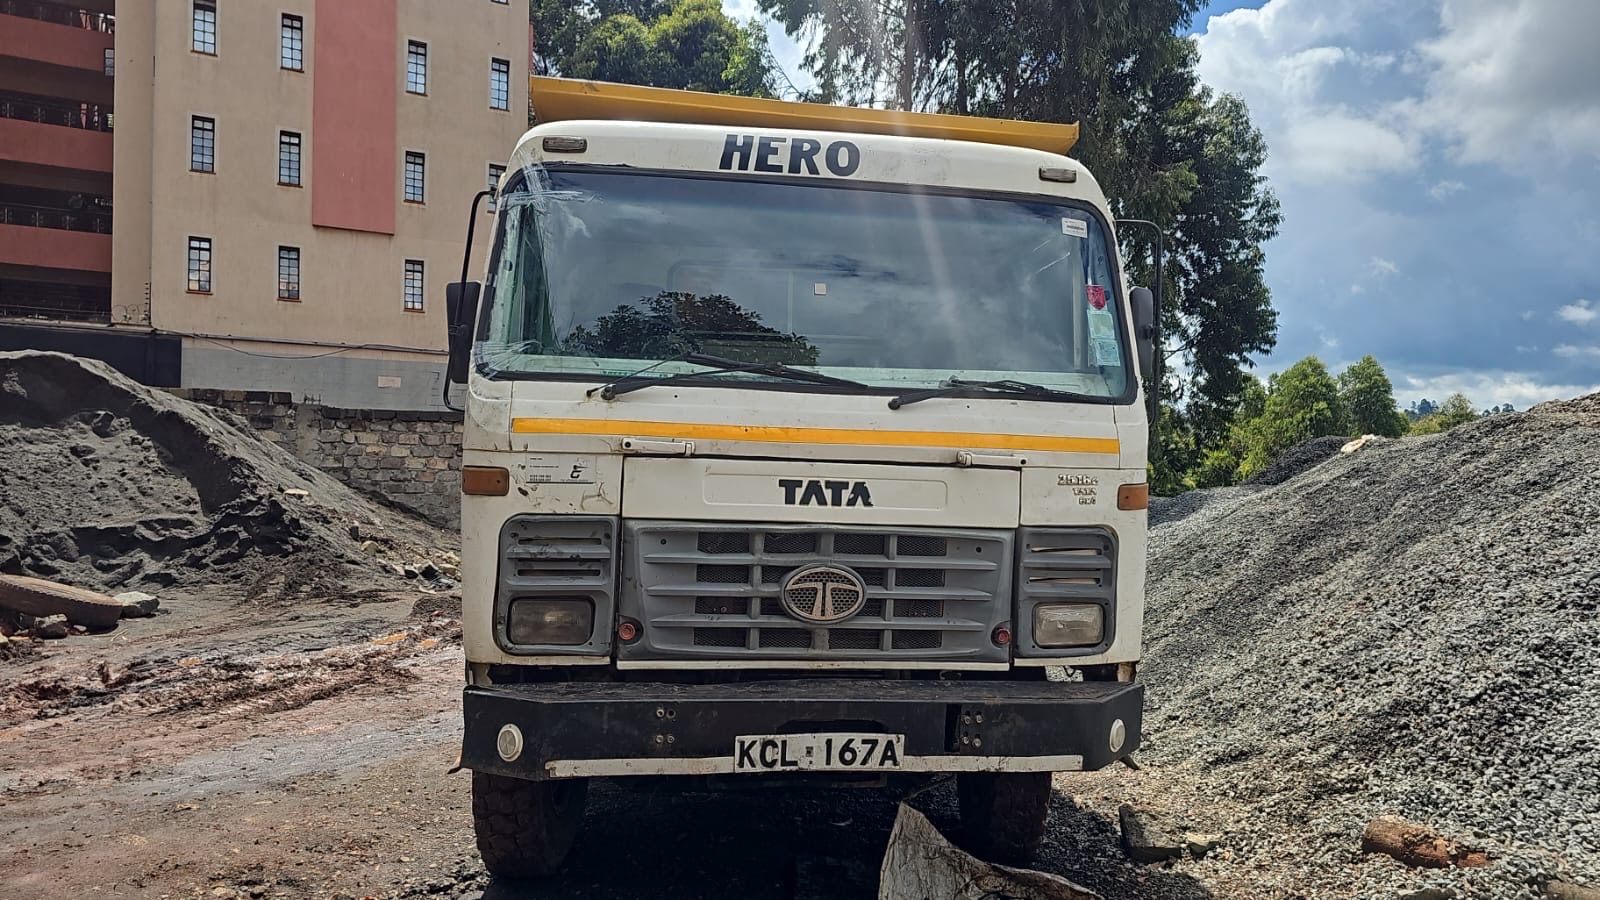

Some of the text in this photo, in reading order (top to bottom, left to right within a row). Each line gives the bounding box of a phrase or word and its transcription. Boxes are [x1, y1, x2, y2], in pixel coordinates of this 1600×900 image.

[719, 134, 860, 177] HERO
[779, 479, 874, 507] TATA
[737, 738, 899, 768] KCL 167A
